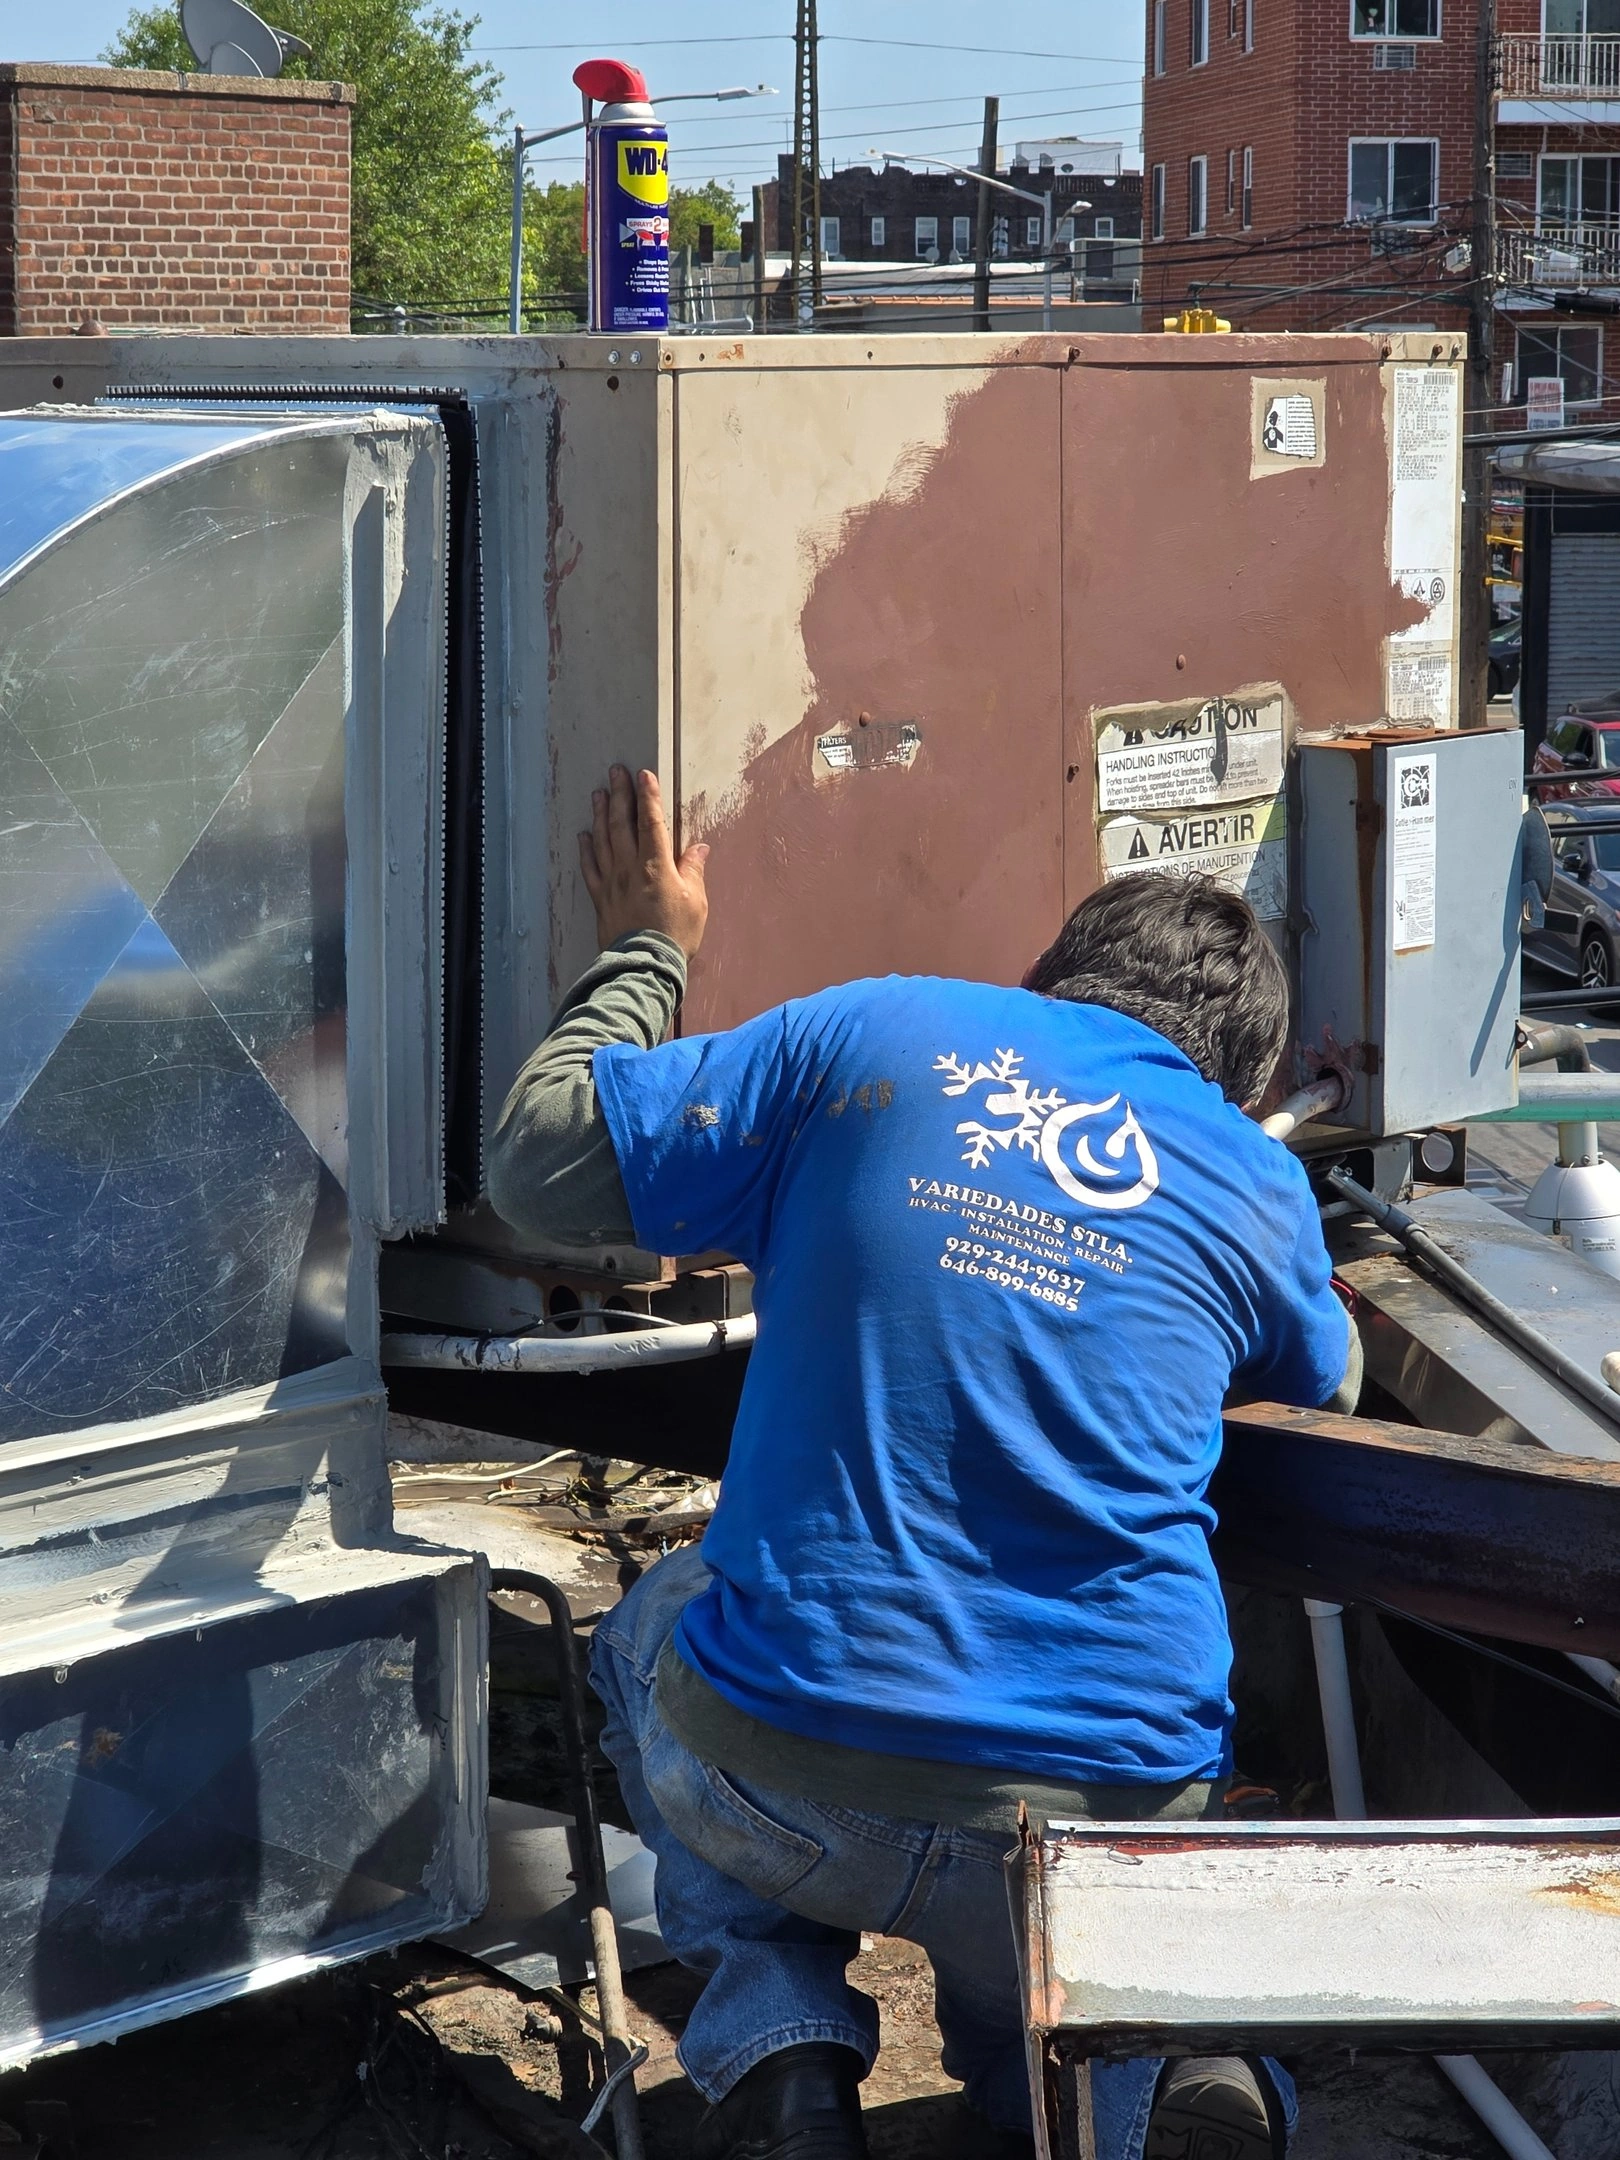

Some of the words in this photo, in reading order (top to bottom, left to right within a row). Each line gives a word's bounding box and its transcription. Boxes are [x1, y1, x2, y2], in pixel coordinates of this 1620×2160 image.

[653, 217, 662, 232] 2
[1106, 754, 1155, 773] HANDLING
[1157, 747, 1216, 766] INSTRUCTIO
[1106, 777, 1122, 787] Forks
[1123, 775, 1137, 784] must
[1106, 788, 1123, 796] When
[1150, 780, 1175, 792] spreader
[1176, 778, 1189, 787] bars
[1190, 776, 1205, 785] must
[1107, 797, 1129, 807] damage
[1139, 793, 1153, 801] sides
[1155, 790, 1166, 799] and
[1167, 790, 1176, 798] top
[1200, 785, 1208, 793] Do
[1228, 781, 1243, 789] more
[1244, 779, 1256, 787] than
[1257, 777, 1267, 785] two
[1159, 813, 1255, 854] AVERTIR
[1197, 848, 1266, 871] MANUTENTION
[909, 1178, 1067, 1234] VARIEDADES
[1071, 1225, 1133, 1264] STLA.
[909, 1197, 952, 1212] HVAC
[960, 1207, 1065, 1249] INSTALLATION
[1074, 1246, 1124, 1275] REPAIR
[968, 1223, 1071, 1266] MAINTENANCE
[940, 1253, 1079, 1312] 646-899-6885
[946, 1236, 1086, 1295] 929-244-9637
